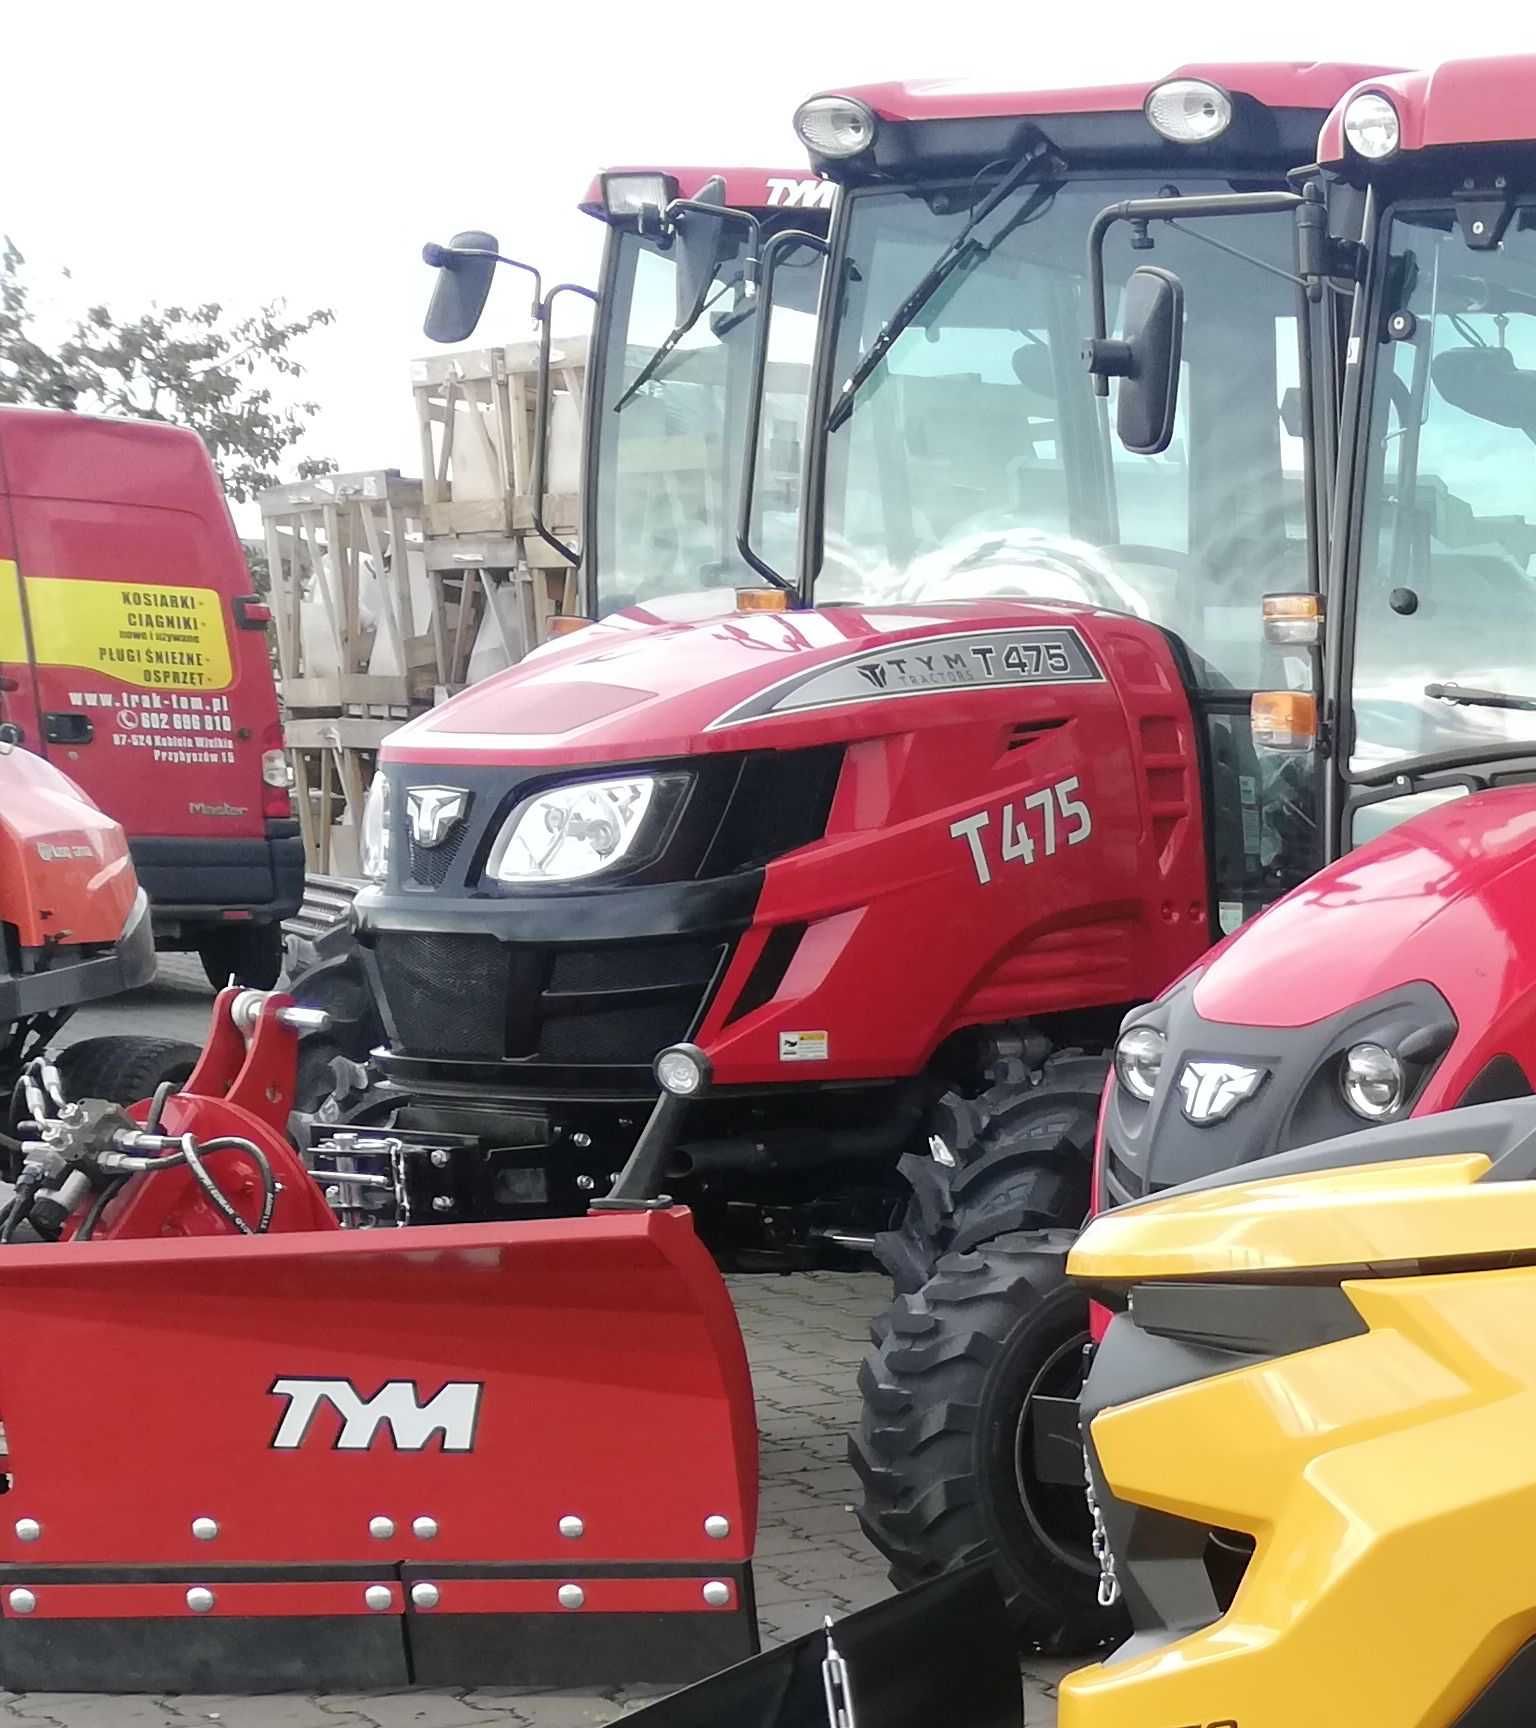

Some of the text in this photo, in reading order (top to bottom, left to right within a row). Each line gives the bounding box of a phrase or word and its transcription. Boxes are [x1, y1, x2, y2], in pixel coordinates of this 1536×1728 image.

[766, 178, 835, 209] TYM
[121, 591, 196, 609] KOSIARKI
[887, 653, 968, 674] TYM
[899, 670, 975, 687] TRACTORS
[140, 712, 170, 729] 602
[949, 775, 1092, 885] T475
[268, 1376, 483, 1451] TYM
